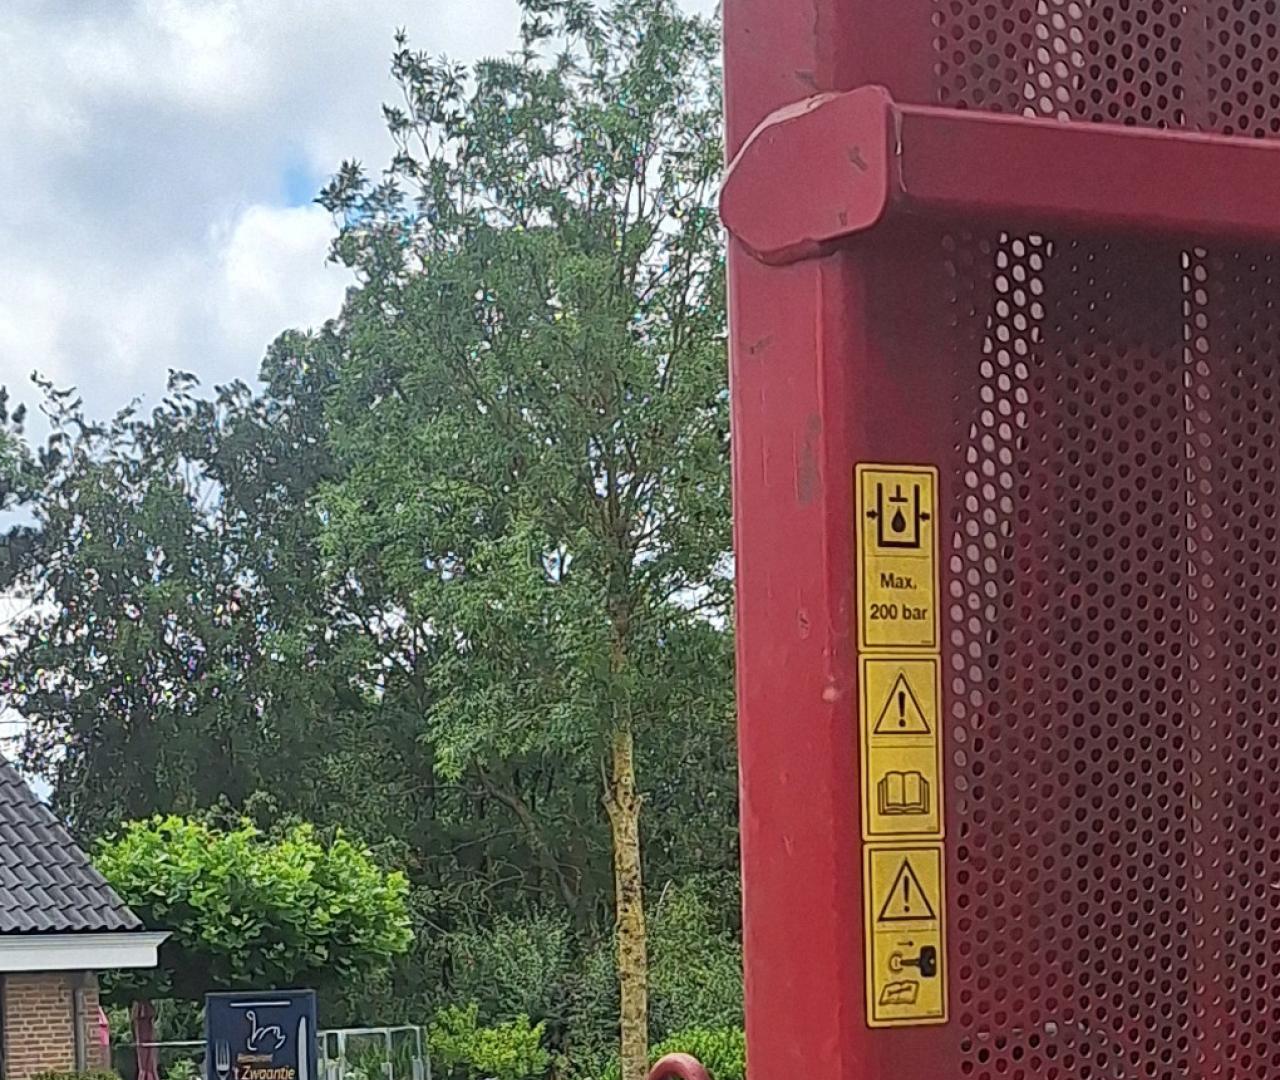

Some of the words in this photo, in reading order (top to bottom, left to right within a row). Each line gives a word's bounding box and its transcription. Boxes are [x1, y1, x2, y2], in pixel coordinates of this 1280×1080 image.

[880, 573, 917, 590] Max.
[870, 604, 897, 620] 200
[902, 604, 928, 620] bar
